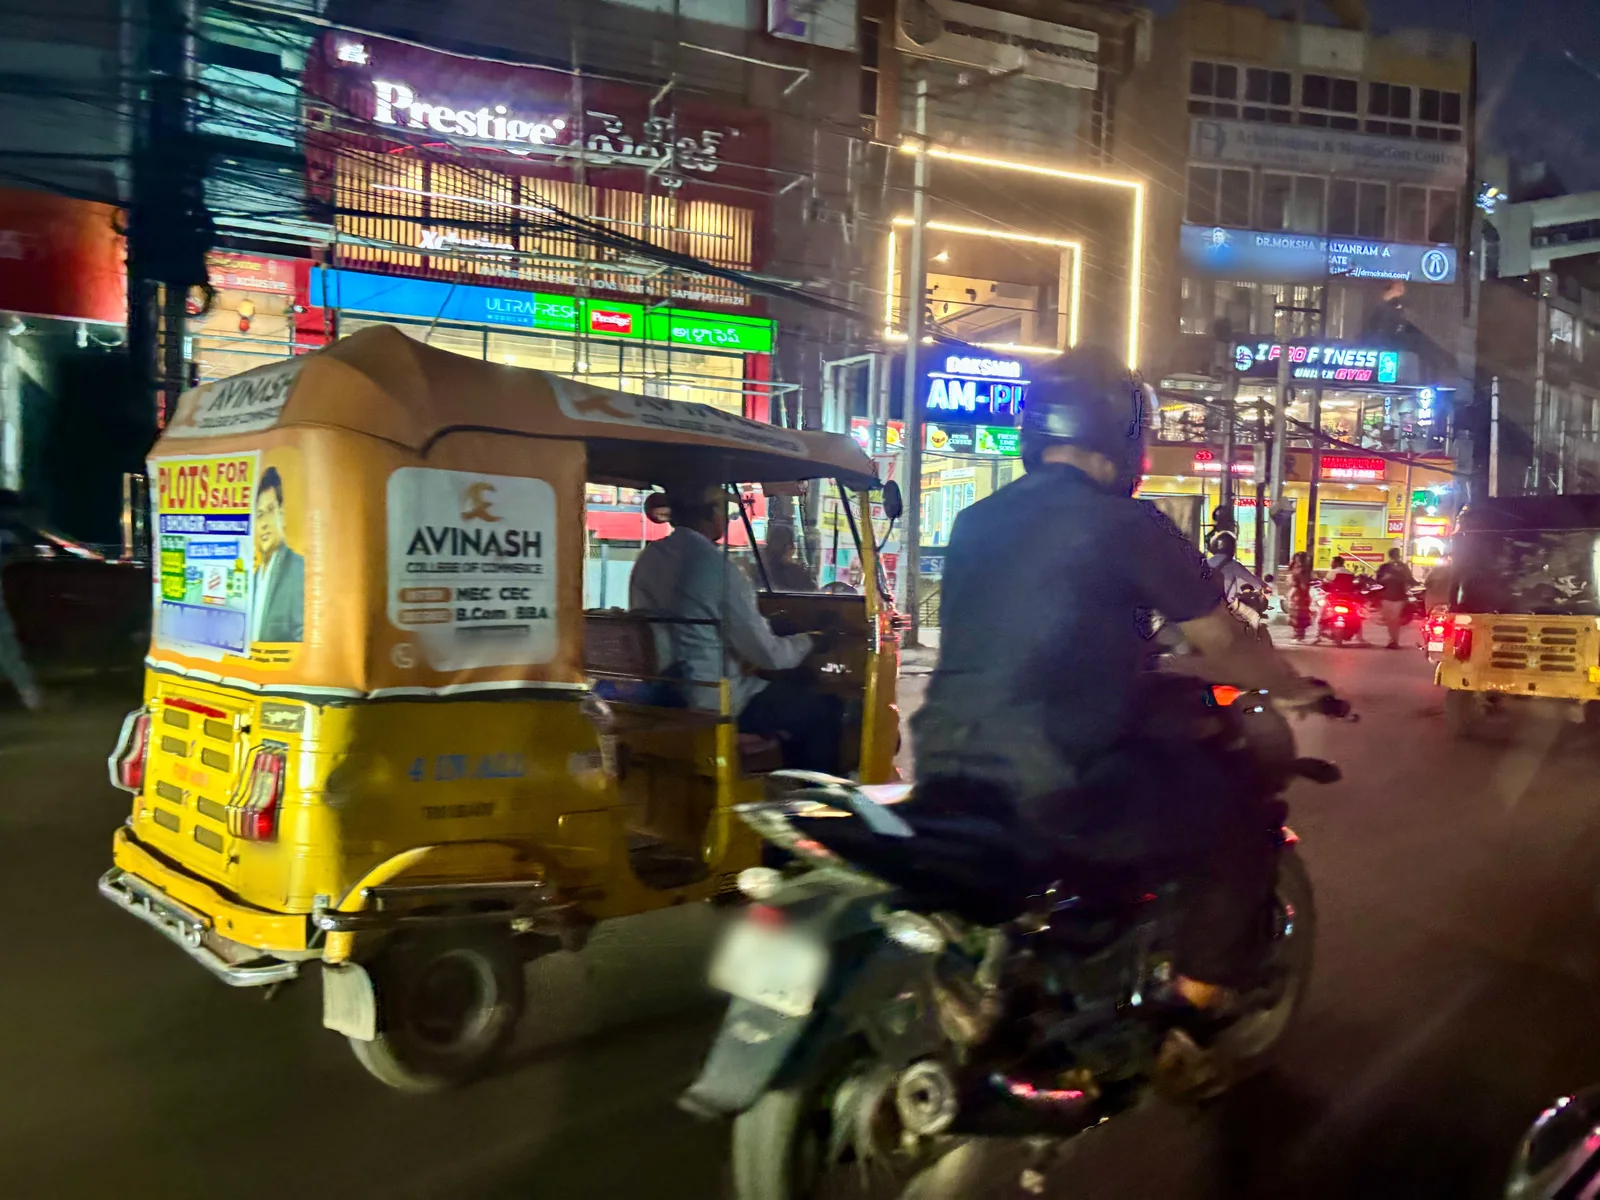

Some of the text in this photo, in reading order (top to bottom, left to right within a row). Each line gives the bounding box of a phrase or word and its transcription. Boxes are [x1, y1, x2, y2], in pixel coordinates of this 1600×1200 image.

[372, 81, 553, 155] Prestige
[1335, 368, 1372, 381] GYM
[158, 461, 249, 509] PLOTS FOR
[210, 486, 251, 508] SALE
[406, 525, 542, 558] AVINASH
[499, 587, 532, 600] CEC
